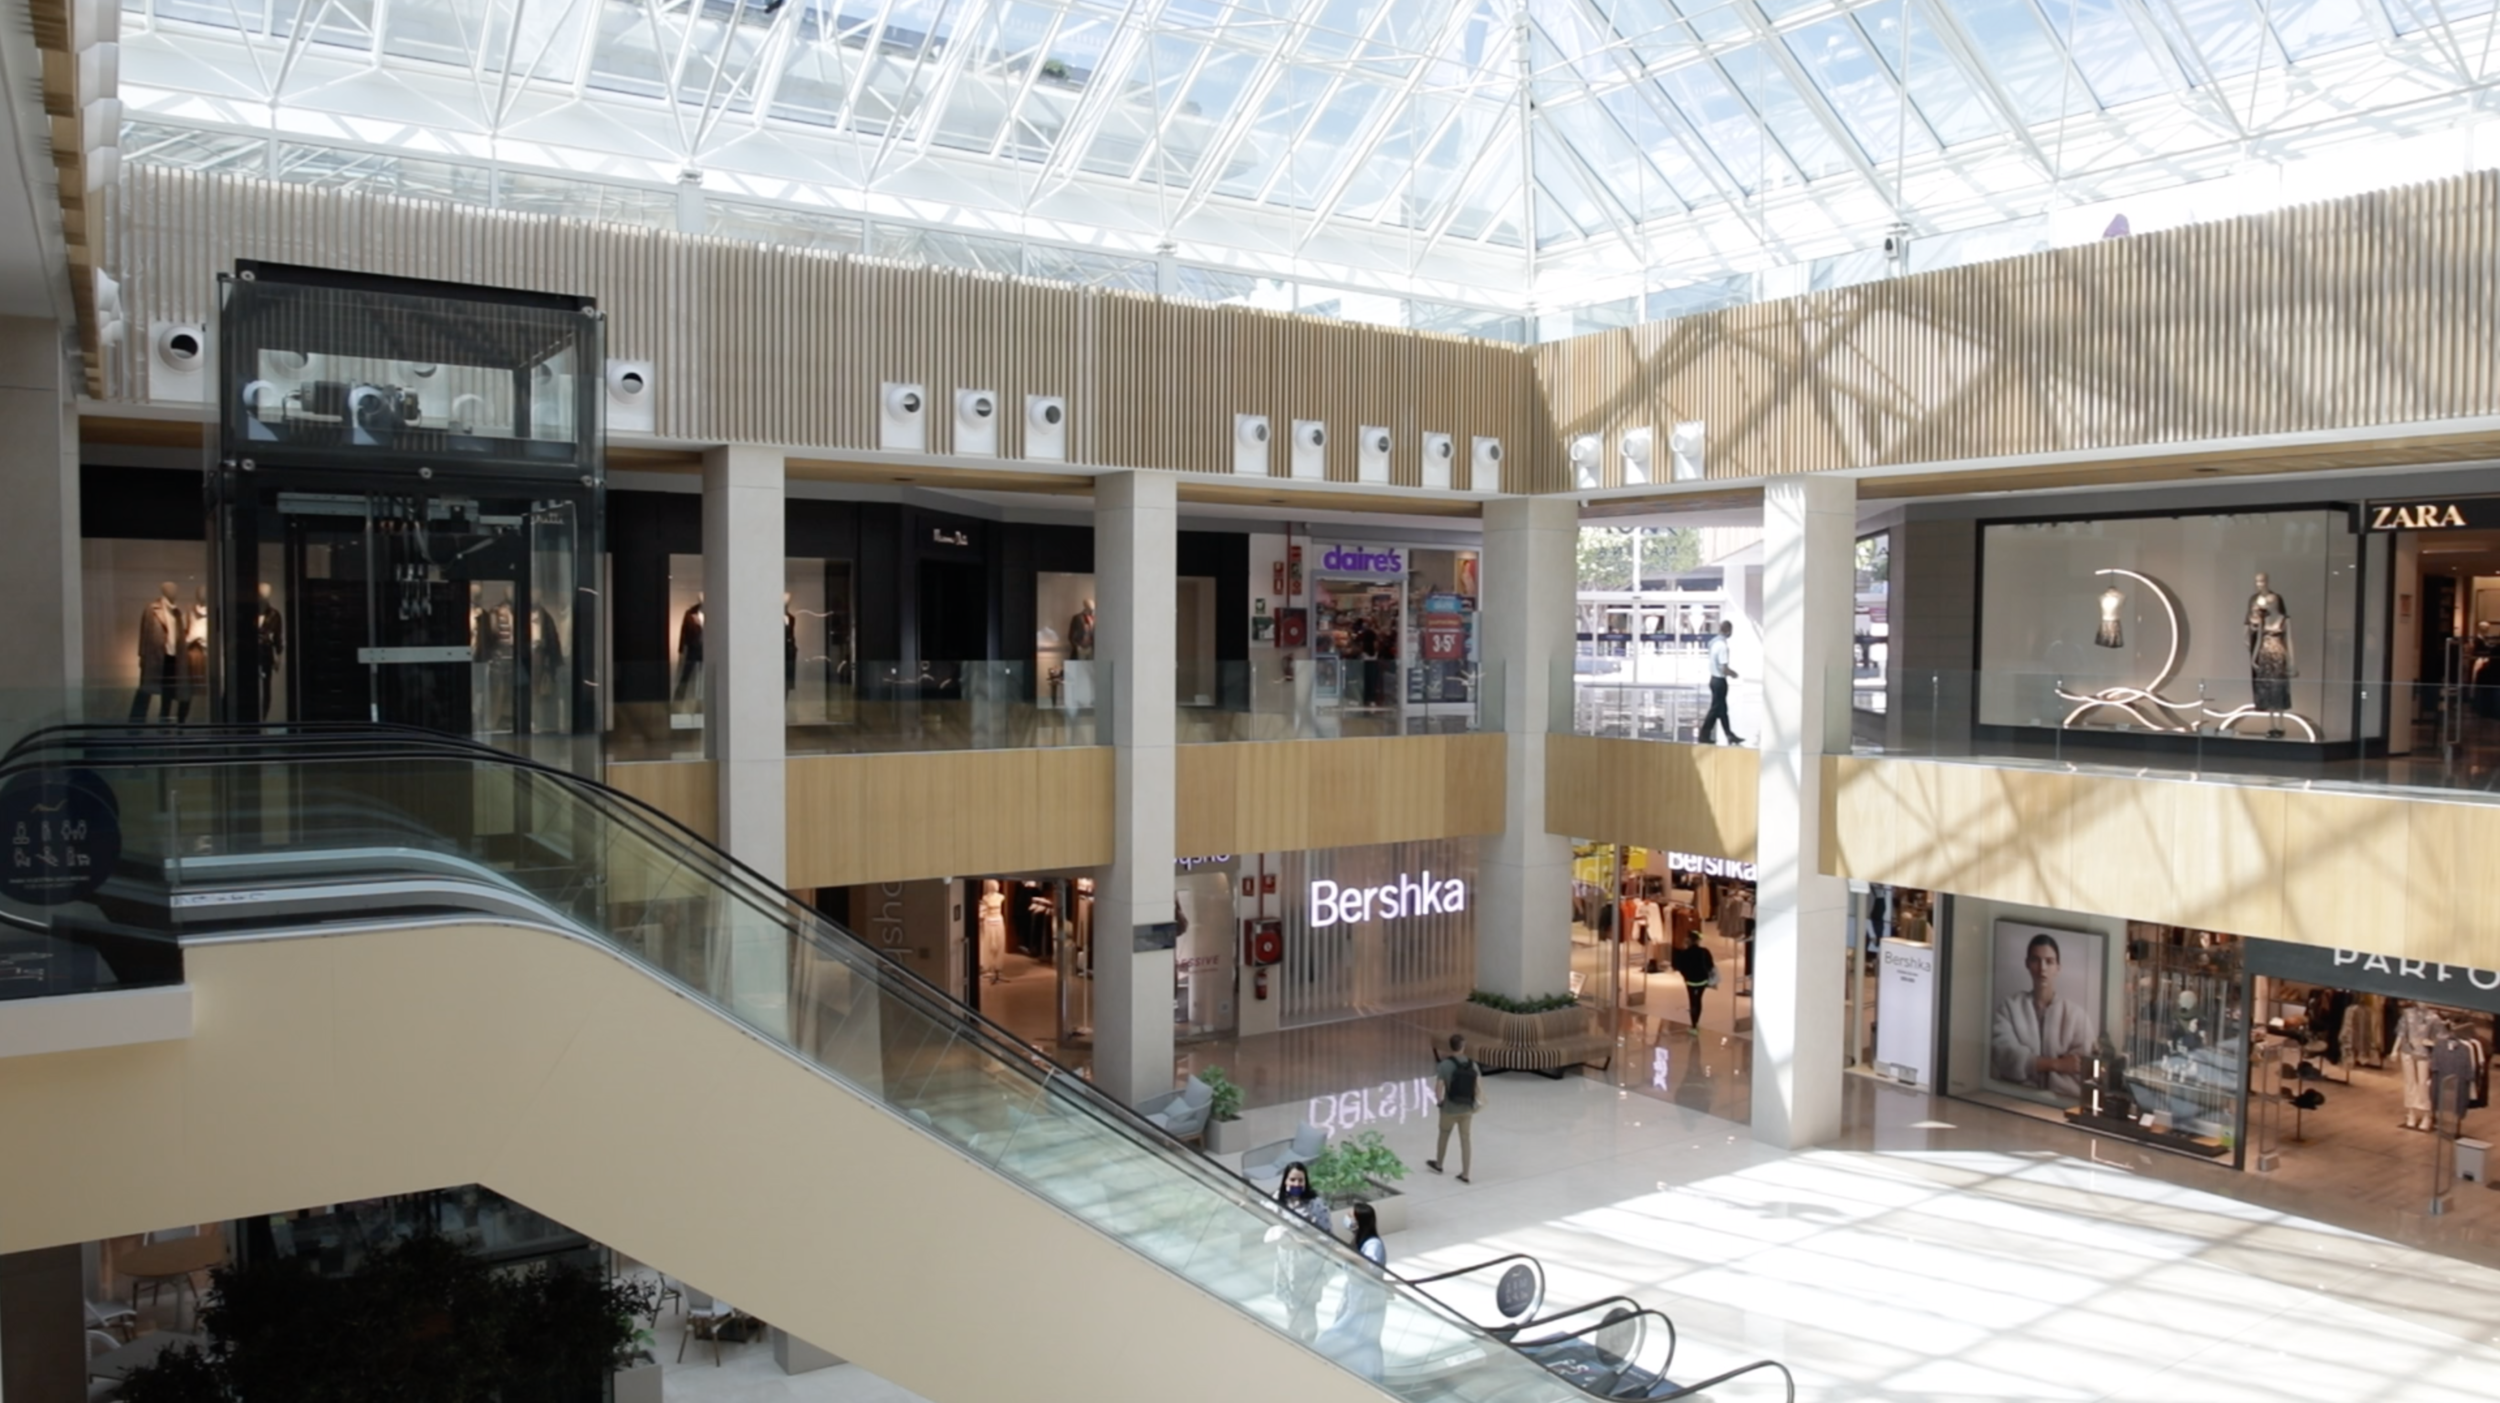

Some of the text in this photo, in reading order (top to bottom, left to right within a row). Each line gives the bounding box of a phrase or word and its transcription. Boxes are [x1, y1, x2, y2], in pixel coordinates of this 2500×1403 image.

[2372, 504, 2467, 529] ZARA
[1323, 545, 1402, 572] claire's
[1311, 870, 1465, 928] Bershka
[1885, 951, 1931, 972] Bershka
